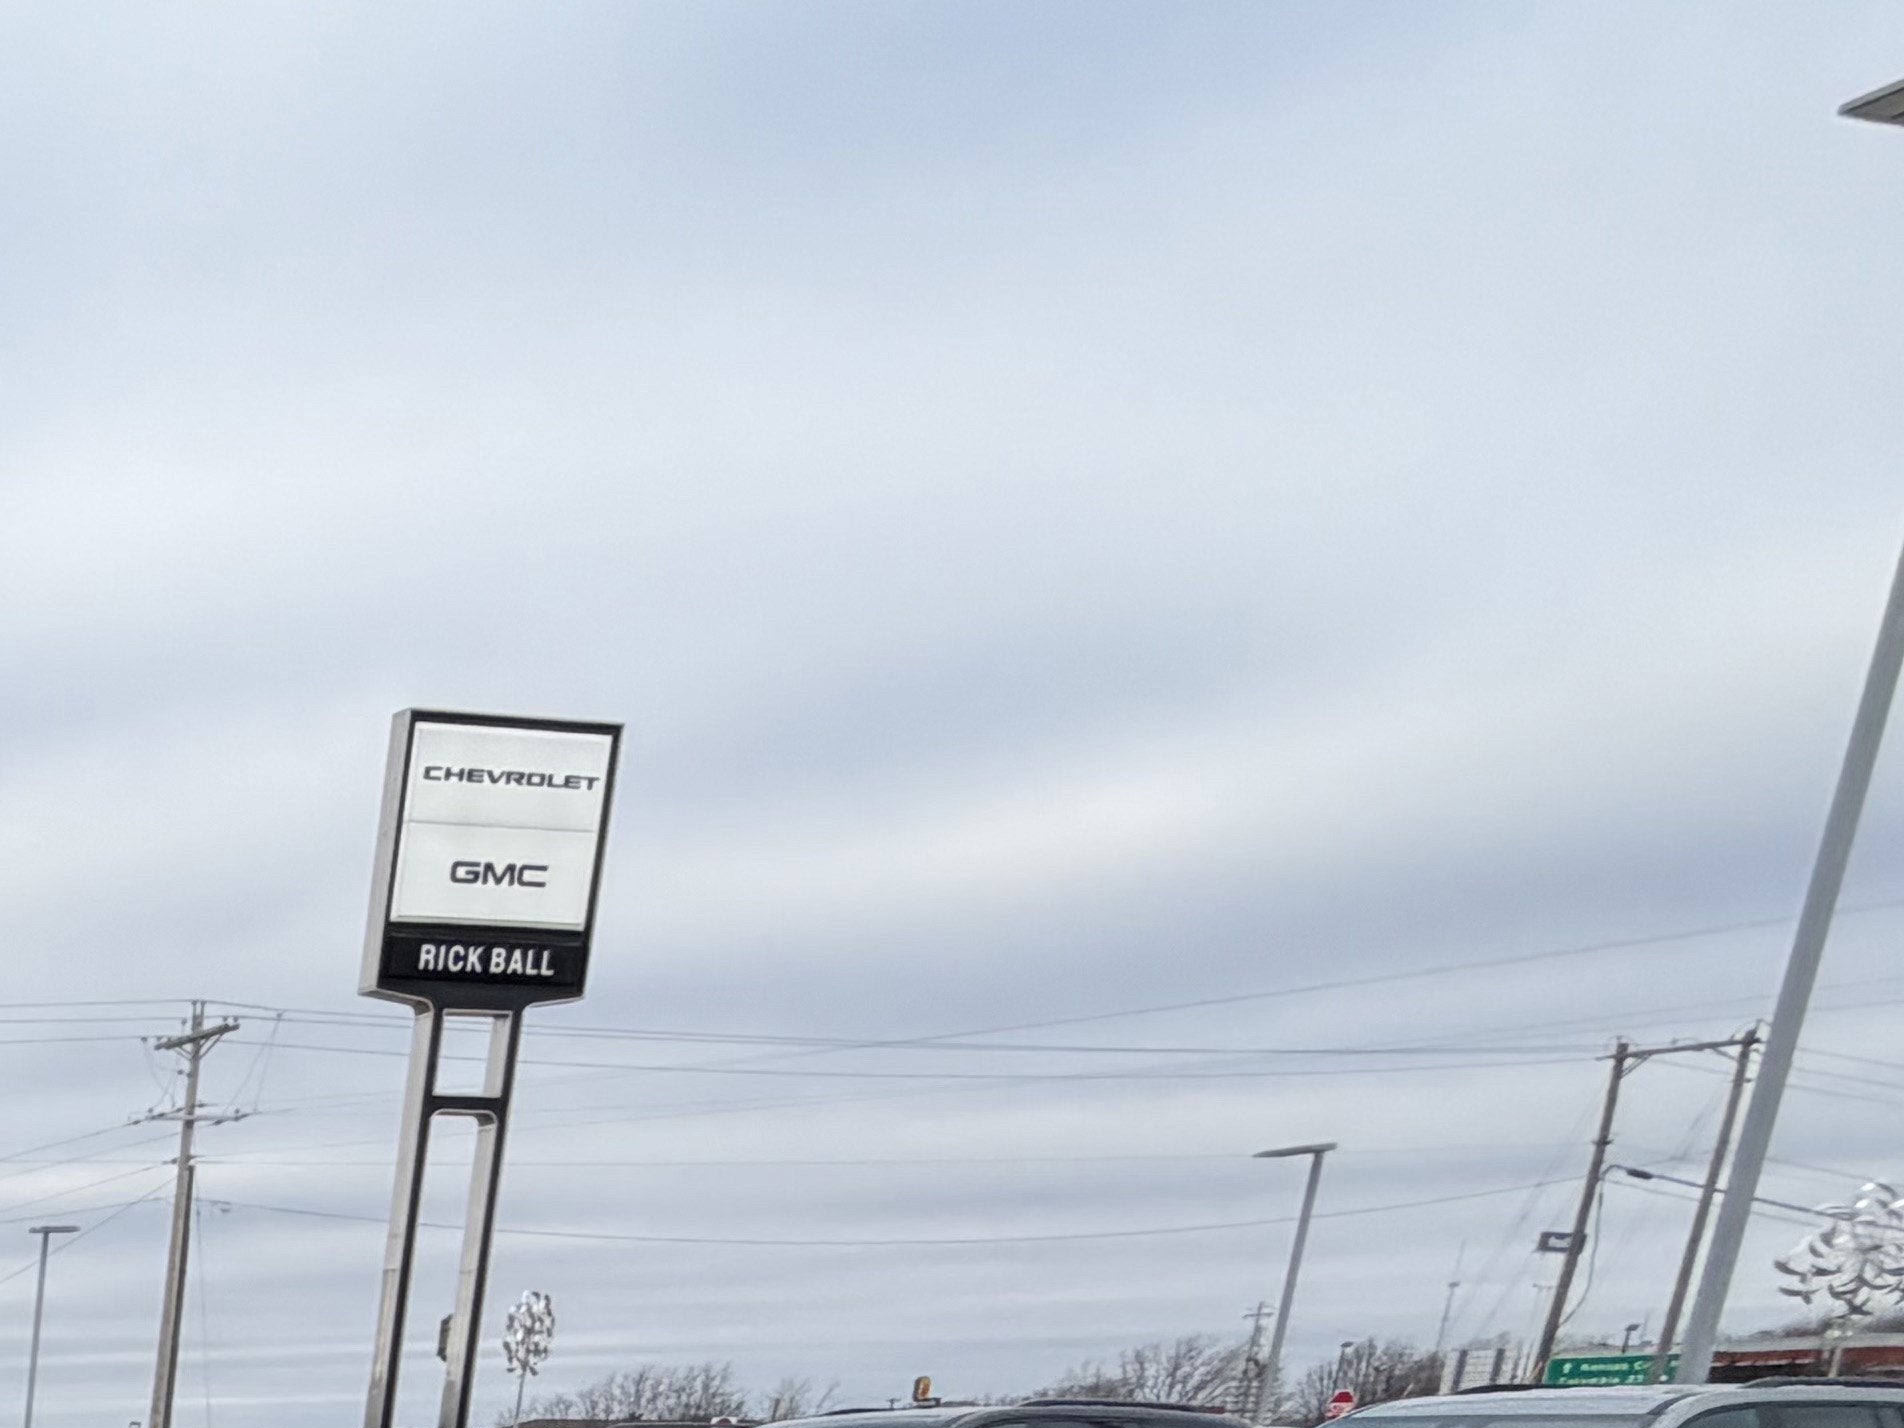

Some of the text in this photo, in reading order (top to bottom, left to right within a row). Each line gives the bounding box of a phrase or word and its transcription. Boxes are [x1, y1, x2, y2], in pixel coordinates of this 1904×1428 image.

[423, 766, 600, 790] CHEVROLET
[450, 860, 549, 887] GMC
[418, 944, 554, 976] RICK BALL
